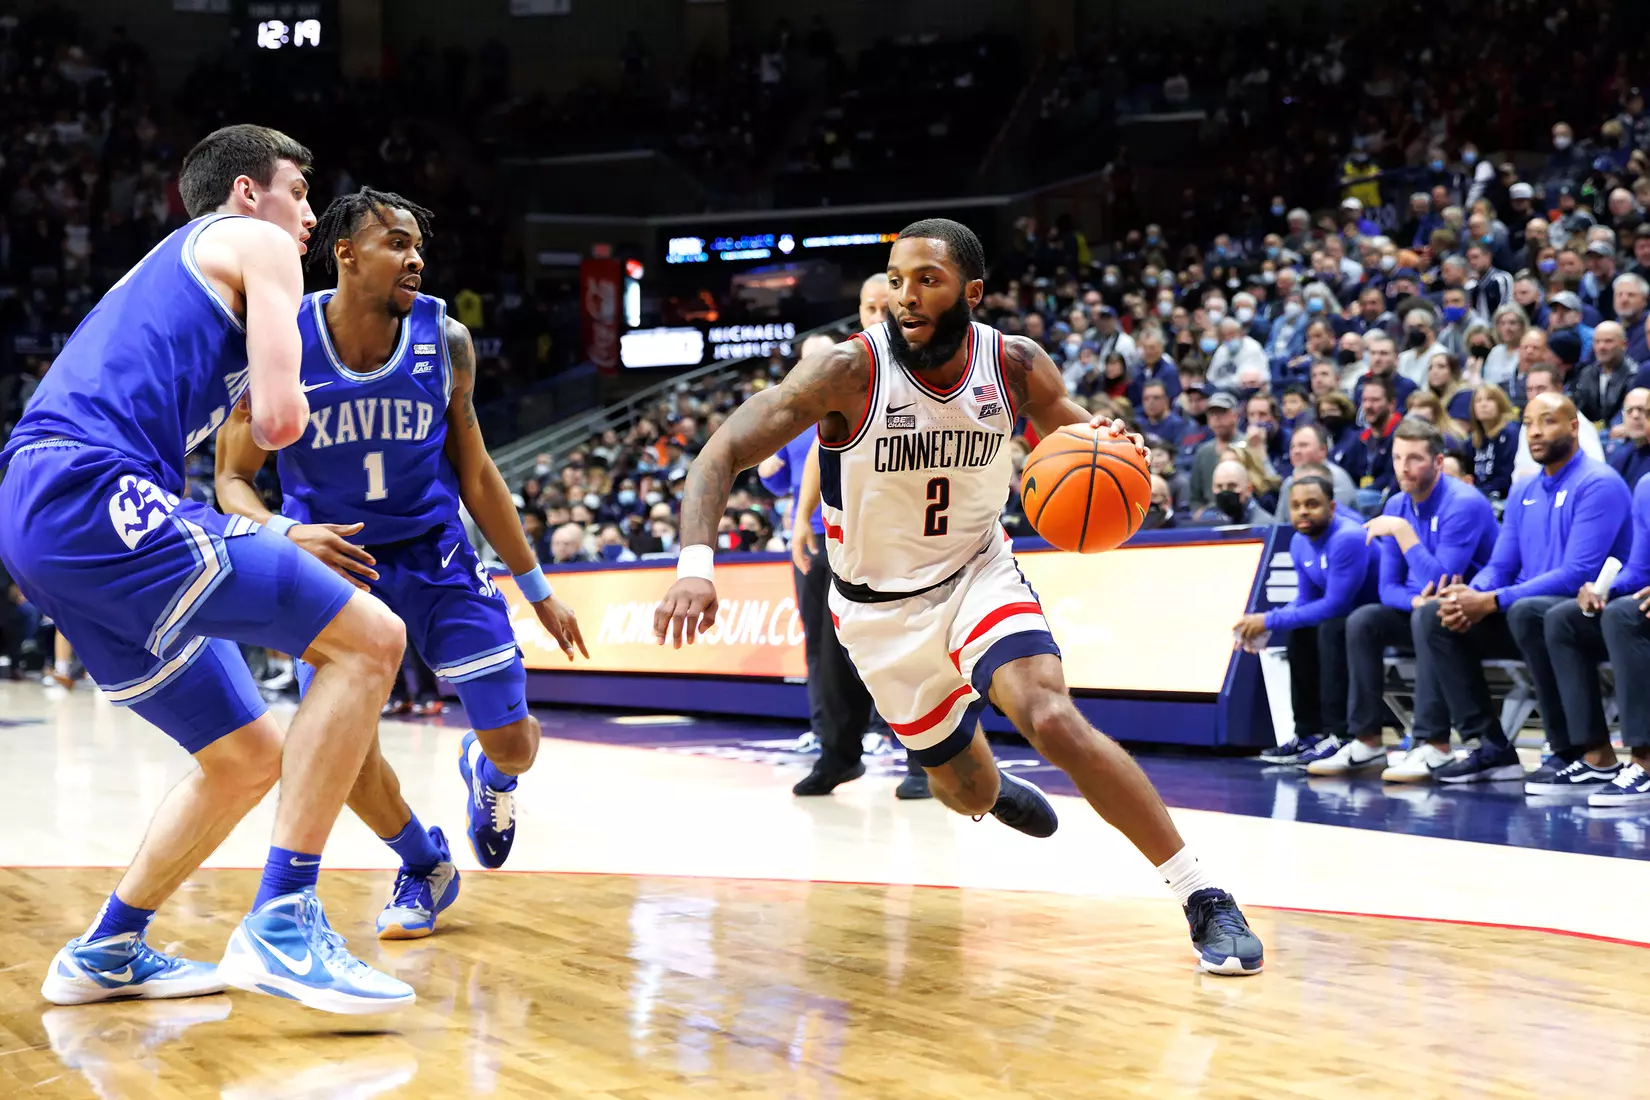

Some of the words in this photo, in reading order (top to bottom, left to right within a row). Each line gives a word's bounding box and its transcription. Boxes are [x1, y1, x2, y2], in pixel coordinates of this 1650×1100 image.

[257, 19, 321, 49] 12:19
[708, 323, 796, 343] MICHAELS
[310, 398, 433, 449] XAVIER
[979, 407, 1003, 417] EAST
[981, 403, 998, 411] BIG
[874, 431, 1004, 473] CONNECTICUT
[363, 451, 388, 501] 1
[923, 476, 950, 537] 2
